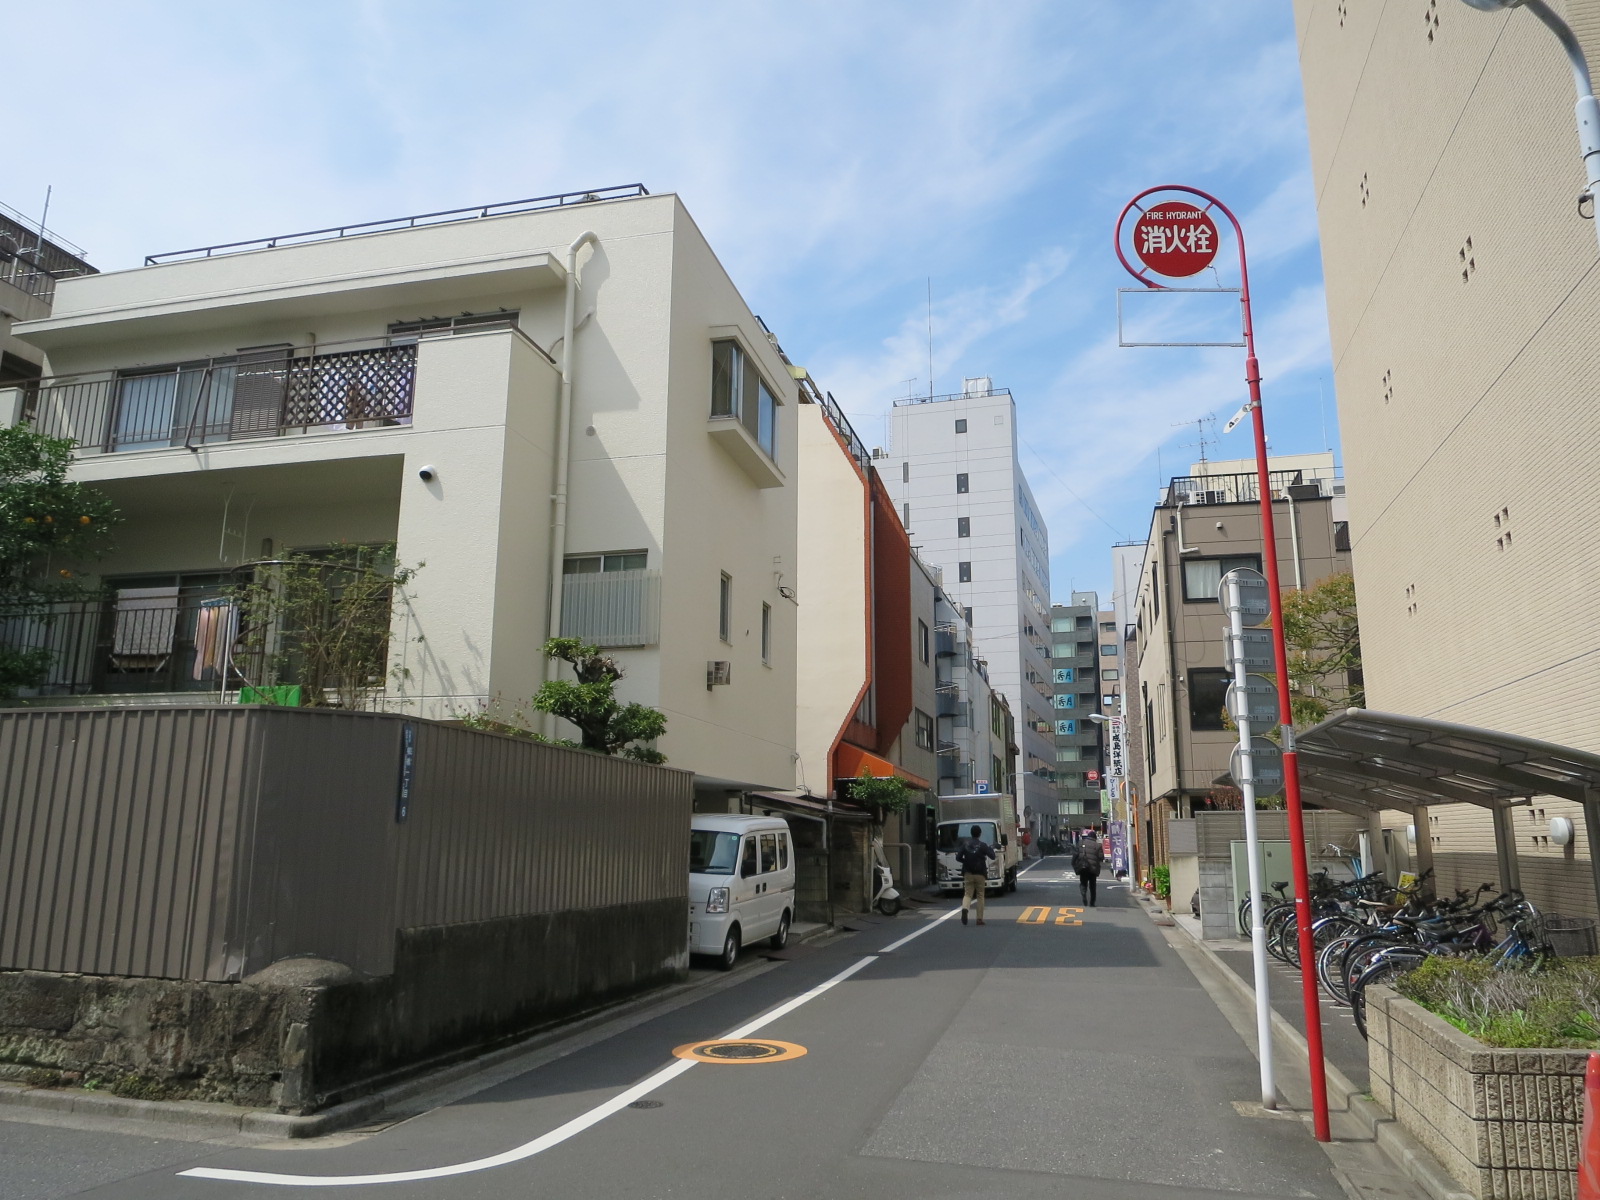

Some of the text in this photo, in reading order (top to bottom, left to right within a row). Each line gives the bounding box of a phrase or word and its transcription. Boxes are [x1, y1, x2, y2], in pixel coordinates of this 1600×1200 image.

[1146, 211, 1203, 220] FIRE HYDRANT
[1141, 224, 1212, 254] 消火栓
[1057, 670, 1072, 681] 秀月
[1058, 696, 1073, 707] 秀月
[1059, 722, 1074, 733] 秀月
[977, 784, 987, 794] P
[1016, 906, 1084, 926] 30
